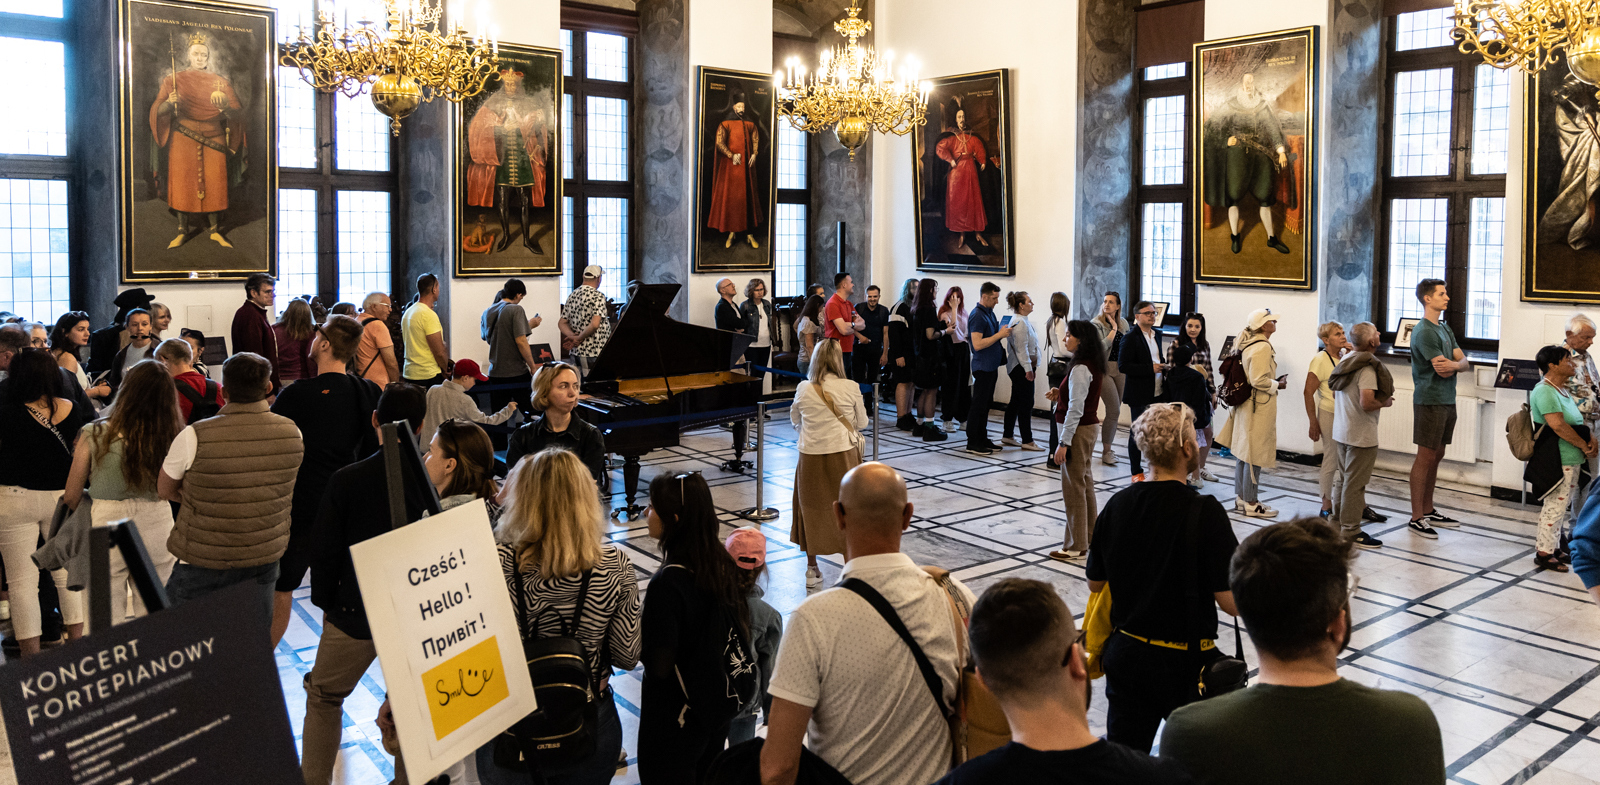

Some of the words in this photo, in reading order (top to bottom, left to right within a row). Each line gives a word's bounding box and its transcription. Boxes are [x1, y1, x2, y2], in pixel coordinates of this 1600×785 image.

[407, 551, 458, 587] Cześć
[419, 590, 463, 621] Hello
[421, 620, 477, 659] Привіт
[20, 638, 139, 699] KONCERT
[26, 637, 214, 727] FORTEPIANOWY
